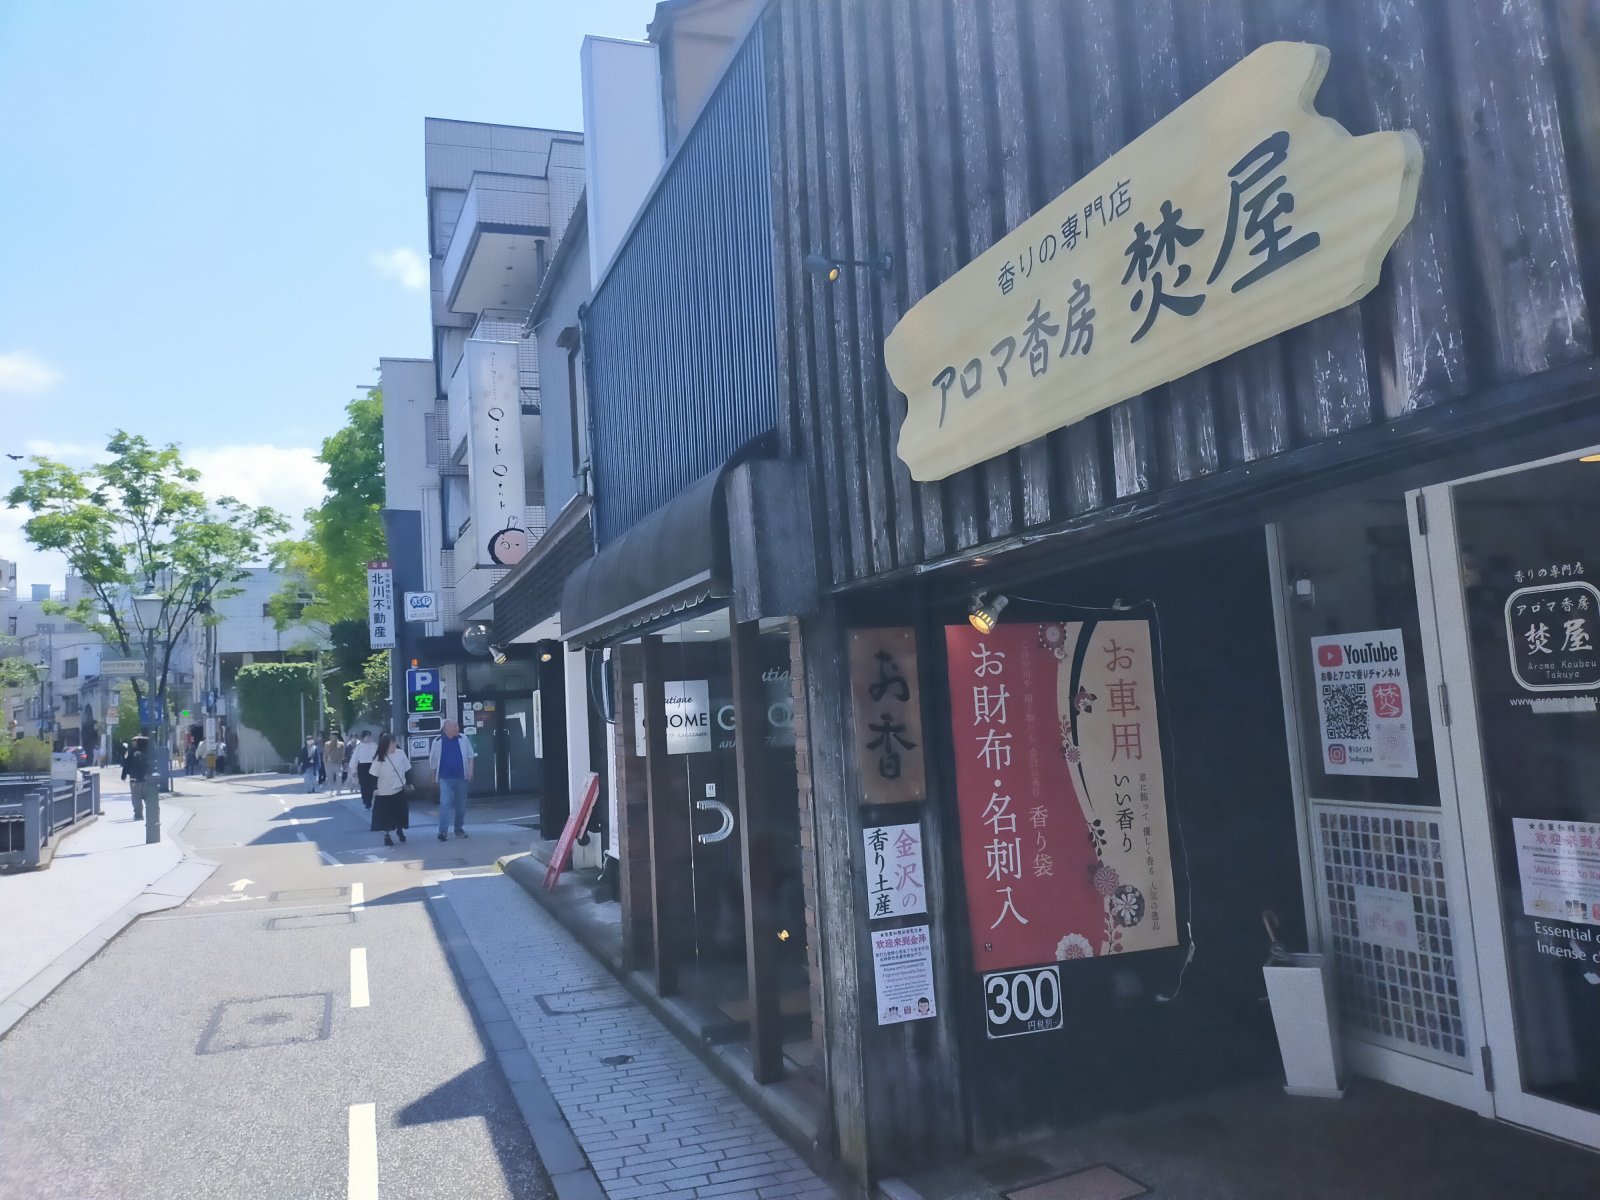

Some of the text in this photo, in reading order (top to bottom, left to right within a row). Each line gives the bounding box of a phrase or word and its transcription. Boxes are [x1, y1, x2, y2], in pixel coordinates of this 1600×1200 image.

[997, 178, 1133, 296] 香りの専門店
[931, 130, 1322, 430] アロマ香房 焚屋
[1514, 561, 1584, 583] 香りの専門店
[371, 572, 387, 638] 北川不動産
[1516, 595, 1590, 617] アロマ香房
[1343, 641, 1399, 664] YouTube
[1524, 618, 1593, 656] 焚屋
[415, 672, 432, 691] P
[1527, 659, 1597, 671] Aroma Koubou
[1546, 670, 1580, 680] Takuya
[415, 693, 434, 711] 空
[866, 648, 918, 782] お香
[1102, 638, 1144, 763] お車用
[664, 713, 708, 728] OME
[970, 642, 1030, 931] お財布・名刺入
[1113, 774, 1135, 853] いい香り
[1028, 805, 1054, 878] 香り袋
[867, 827, 895, 917] 香り土産
[892, 828, 923, 909] 金沢の
[1578, 869, 1588, 879] to
[1534, 921, 1592, 943] Essential
[1536, 940, 1587, 961] Incense
[987, 970, 1059, 1025] 300
